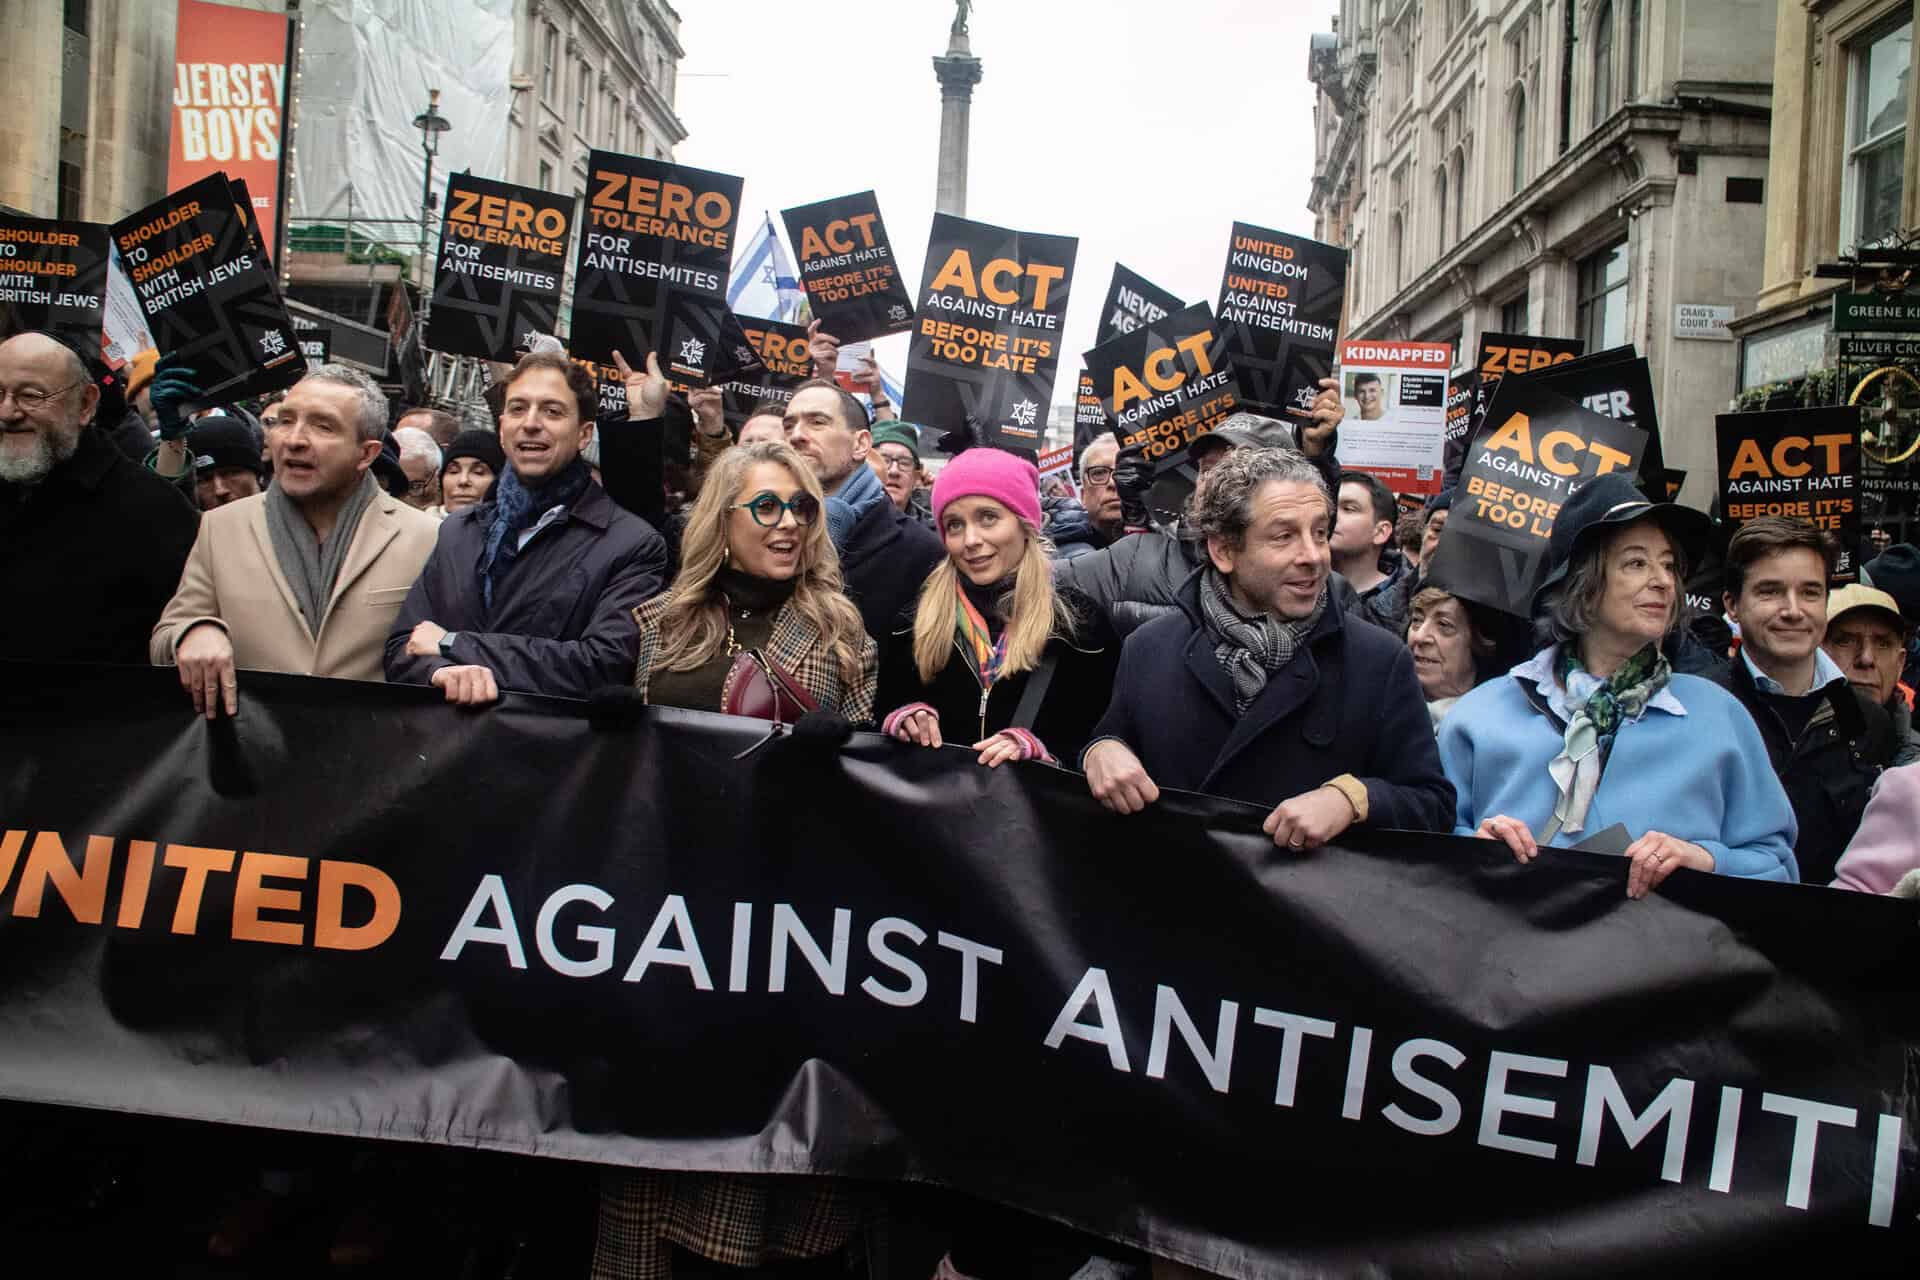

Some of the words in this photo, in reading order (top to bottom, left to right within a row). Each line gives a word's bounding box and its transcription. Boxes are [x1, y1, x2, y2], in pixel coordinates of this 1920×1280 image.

[174, 63, 286, 107] JERSEY
[181, 107, 279, 162] BOYS
[450, 190, 566, 239] ZERO
[591, 170, 732, 229] ZERO
[119, 201, 202, 251] SHOULDER
[447, 220, 563, 257] TOLERANCE
[590, 207, 729, 250] TOLERANCE
[800, 213, 878, 262] ACT
[125, 247, 148, 266] TO
[132, 233, 216, 283] SHOULDER
[444, 241, 481, 260] FOR
[586, 233, 631, 254] FOR
[1234, 236, 1294, 261] UNITED
[441, 258, 556, 290] ANTISEMITES
[584, 253, 719, 291] ANTISEMITES
[804, 253, 852, 274] AGAINST
[855, 246, 888, 263] HATE
[1231, 252, 1308, 281] KINGDOM
[138, 269, 181, 299] WITH
[145, 277, 204, 315] BRITISH
[207, 255, 253, 286] JEWS
[807, 271, 861, 293] BEFORE
[863, 264, 894, 282] IT'S
[818, 283, 849, 303] TOO
[851, 277, 889, 299] LATE
[929, 248, 1065, 312] ACT
[1228, 275, 1288, 299] UNITED
[54, 293, 99, 309] JEWS
[927, 293, 1007, 322] AGAINST
[1011, 311, 1057, 329] HATE
[1223, 290, 1297, 317] AGAINST
[1848, 305, 1902, 317] GREENE
[921, 318, 1008, 352] BEFORE
[1012, 337, 1051, 356] IT'S
[1220, 306, 1334, 342] ANTISEMITISM
[1680, 318, 1709, 329] COURT
[744, 329, 811, 363] ERO
[931, 339, 977, 363] TOO
[982, 349, 1038, 374] LATE
[1345, 346, 1446, 363] KIDNAPPED
[1847, 341, 1892, 353] SILVER
[1113, 329, 1214, 414] ACT
[600, 384, 626, 399] FOR
[719, 381, 793, 402] NTISEMITE
[1079, 386, 1093, 395] TO
[1117, 388, 1183, 428] AGAINST
[1186, 370, 1229, 400] HATE
[1078, 405, 1103, 416] WITH
[1123, 409, 1197, 446] BEFORE
[1201, 393, 1235, 424] IT'S
[1141, 435, 1180, 462] TOO
[1482, 411, 1631, 477] ACT
[1728, 433, 1853, 479] ACT
[1477, 451, 1564, 491] AGAINST
[1728, 478, 1803, 494] AGAINST
[1807, 475, 1854, 491] HATE
[1861, 480, 1910, 490] NSTAIRS
[1467, 476, 1561, 521] BEFORE
[1477, 499, 1526, 529] TOO
[1728, 501, 1810, 518] BEFORE
[1815, 498, 1854, 515] IT'S
[440, 874, 1003, 1024] AGAINST
[1043, 967, 1904, 1229] ANTISEMITI
